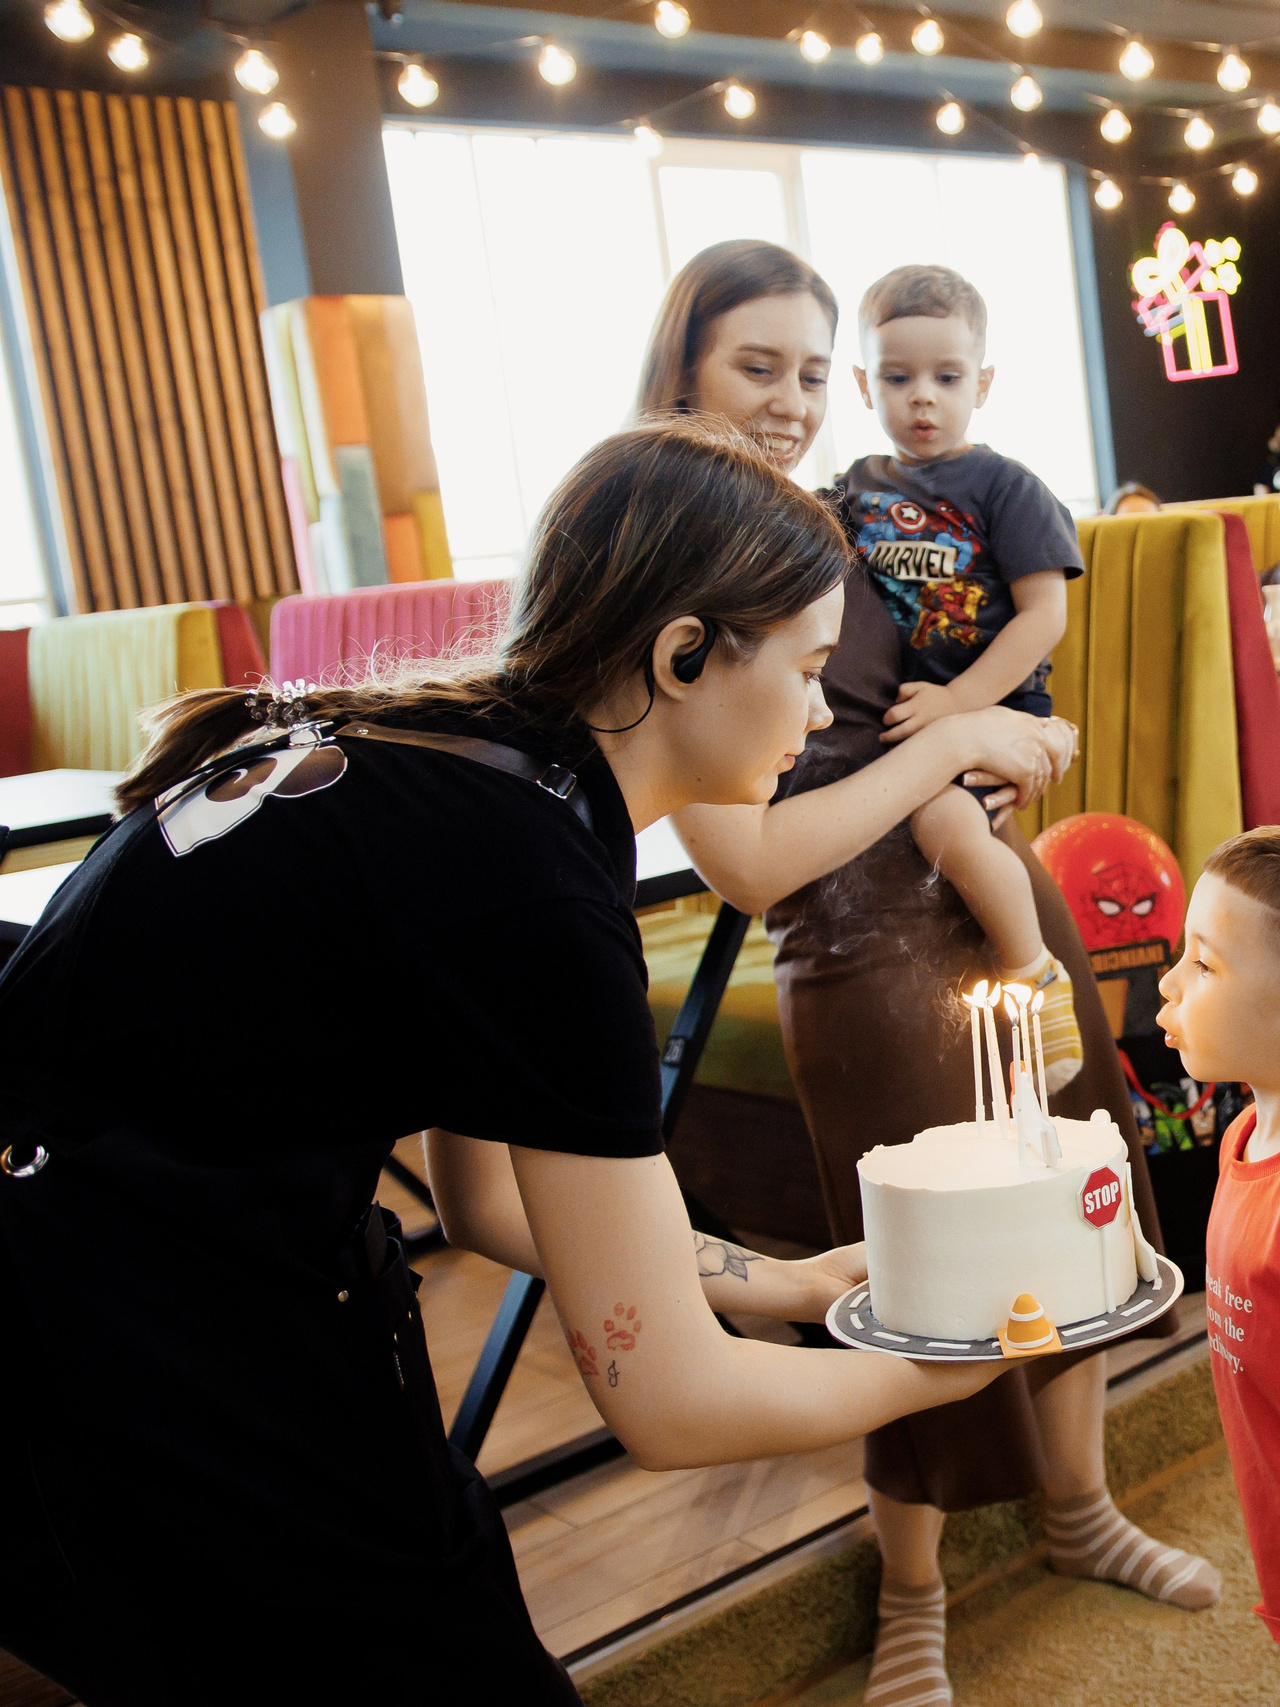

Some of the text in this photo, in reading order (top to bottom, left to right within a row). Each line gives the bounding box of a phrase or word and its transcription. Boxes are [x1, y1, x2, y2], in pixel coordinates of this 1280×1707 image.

[868, 545, 954, 578] MARVEL
[1084, 1181, 1119, 1214] STOP
[1224, 1284, 1253, 1314] free
[1224, 1316, 1245, 1342] the
